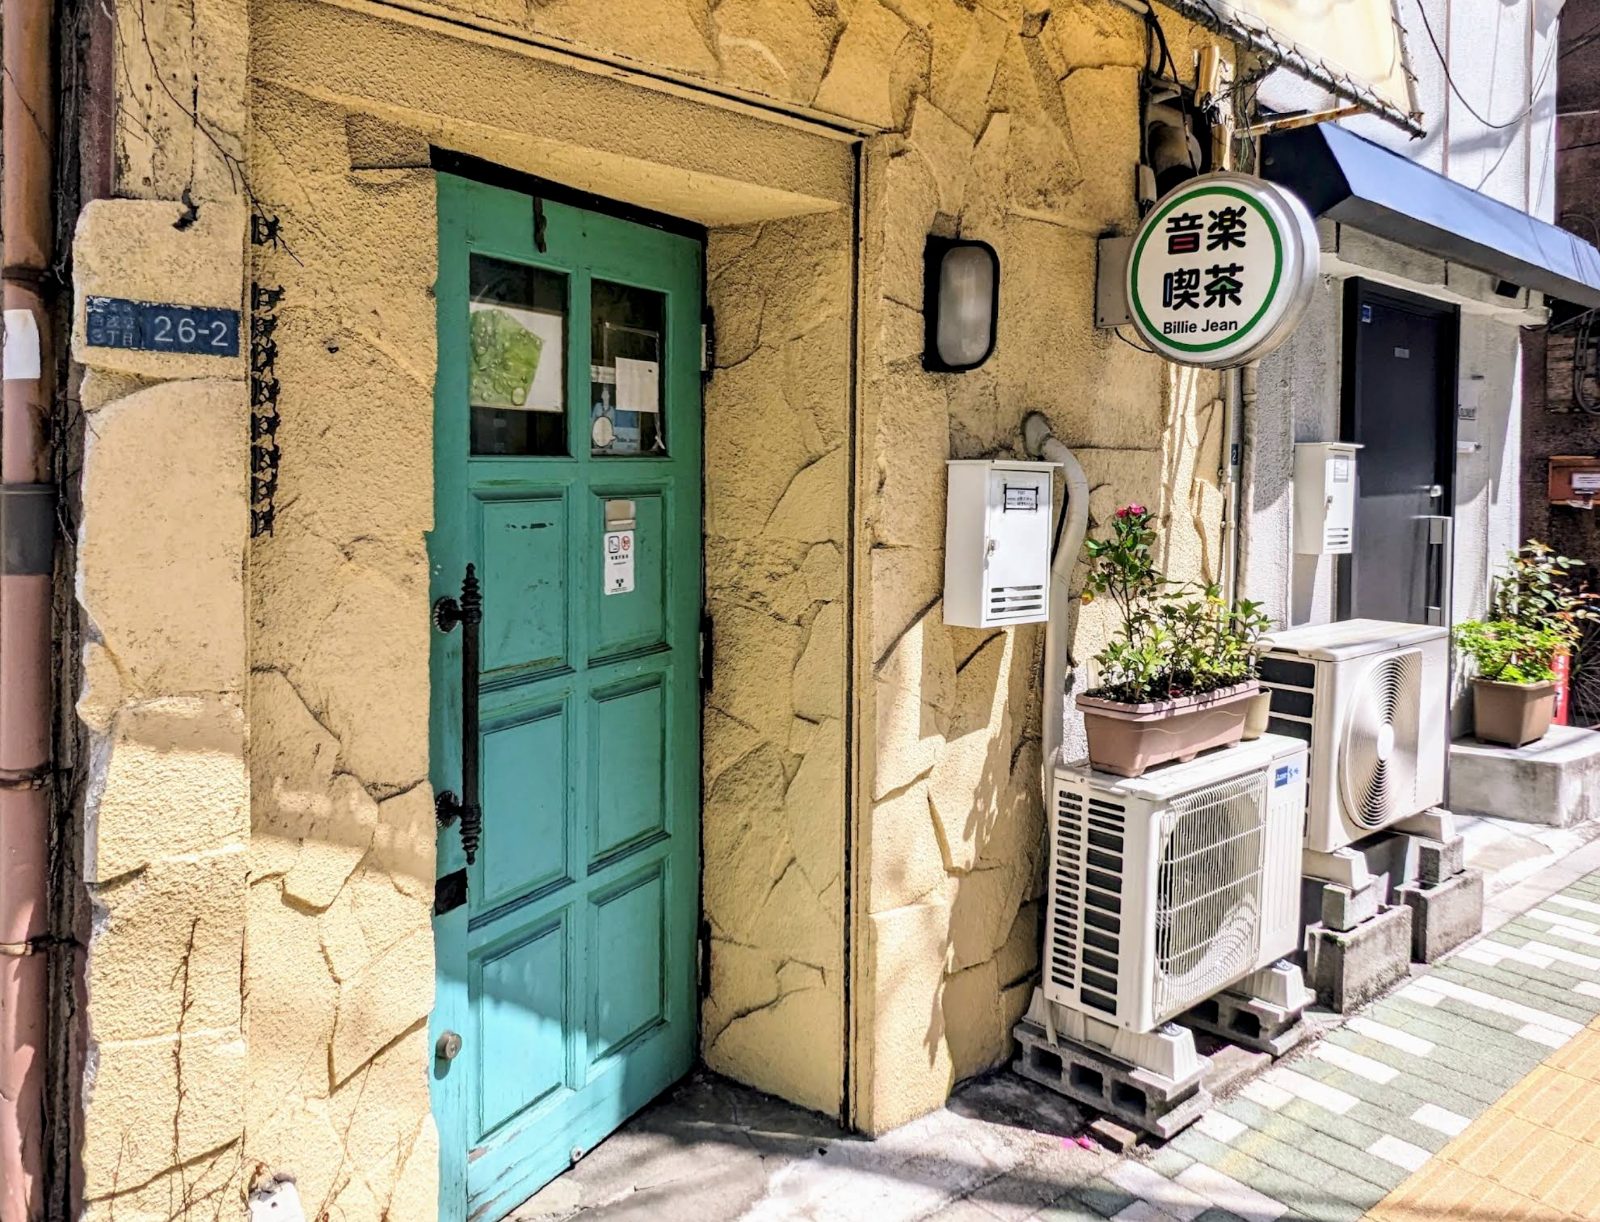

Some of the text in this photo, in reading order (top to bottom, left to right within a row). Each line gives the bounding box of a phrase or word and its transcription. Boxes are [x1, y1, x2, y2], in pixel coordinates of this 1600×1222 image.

[1165, 205, 1248, 256] 音楽
[1162, 262, 1245, 311] 喫茶
[153, 315, 229, 347] 26-2
[1163, 319, 1239, 335] Billie Jean
